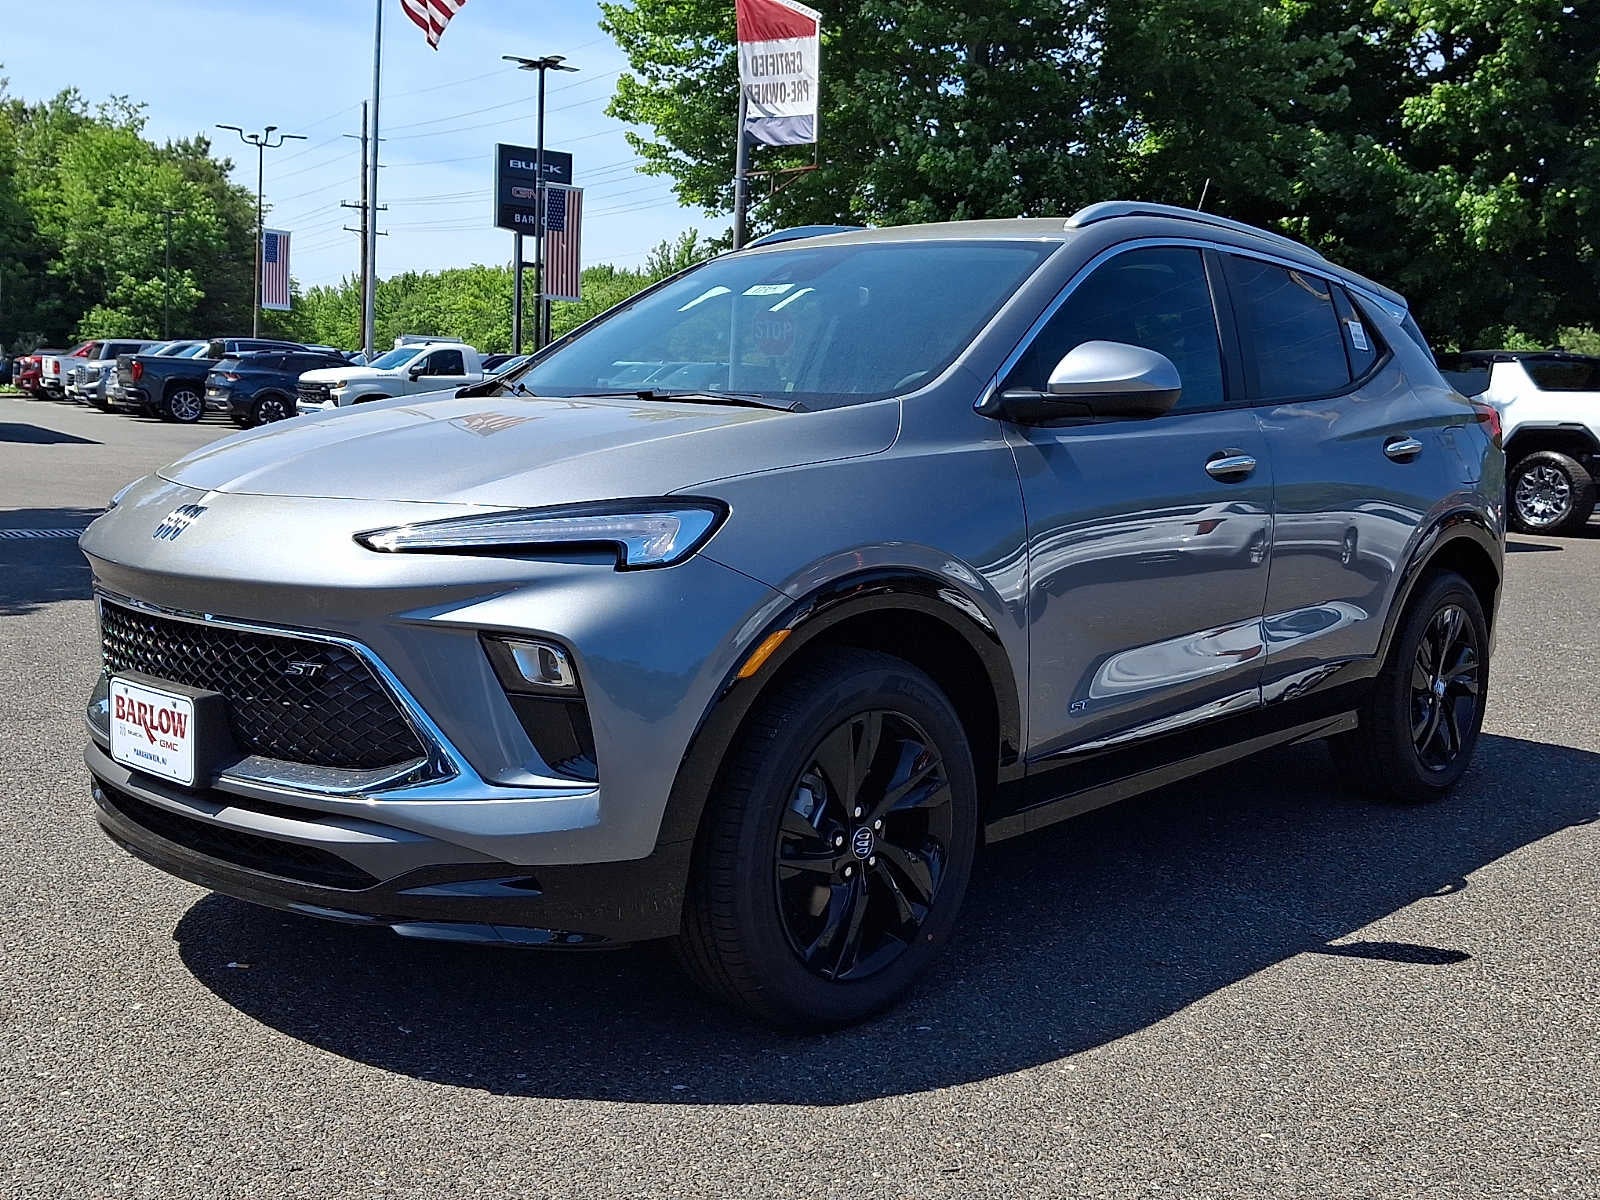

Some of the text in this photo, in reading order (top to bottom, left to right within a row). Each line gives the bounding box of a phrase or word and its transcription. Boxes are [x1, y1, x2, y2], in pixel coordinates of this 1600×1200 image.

[754, 321, 793, 340] STOP
[285, 661, 325, 677] ST
[1070, 699, 1089, 713] ST
[115, 695, 188, 745] BARLOW
[159, 739, 179, 752] GMC
